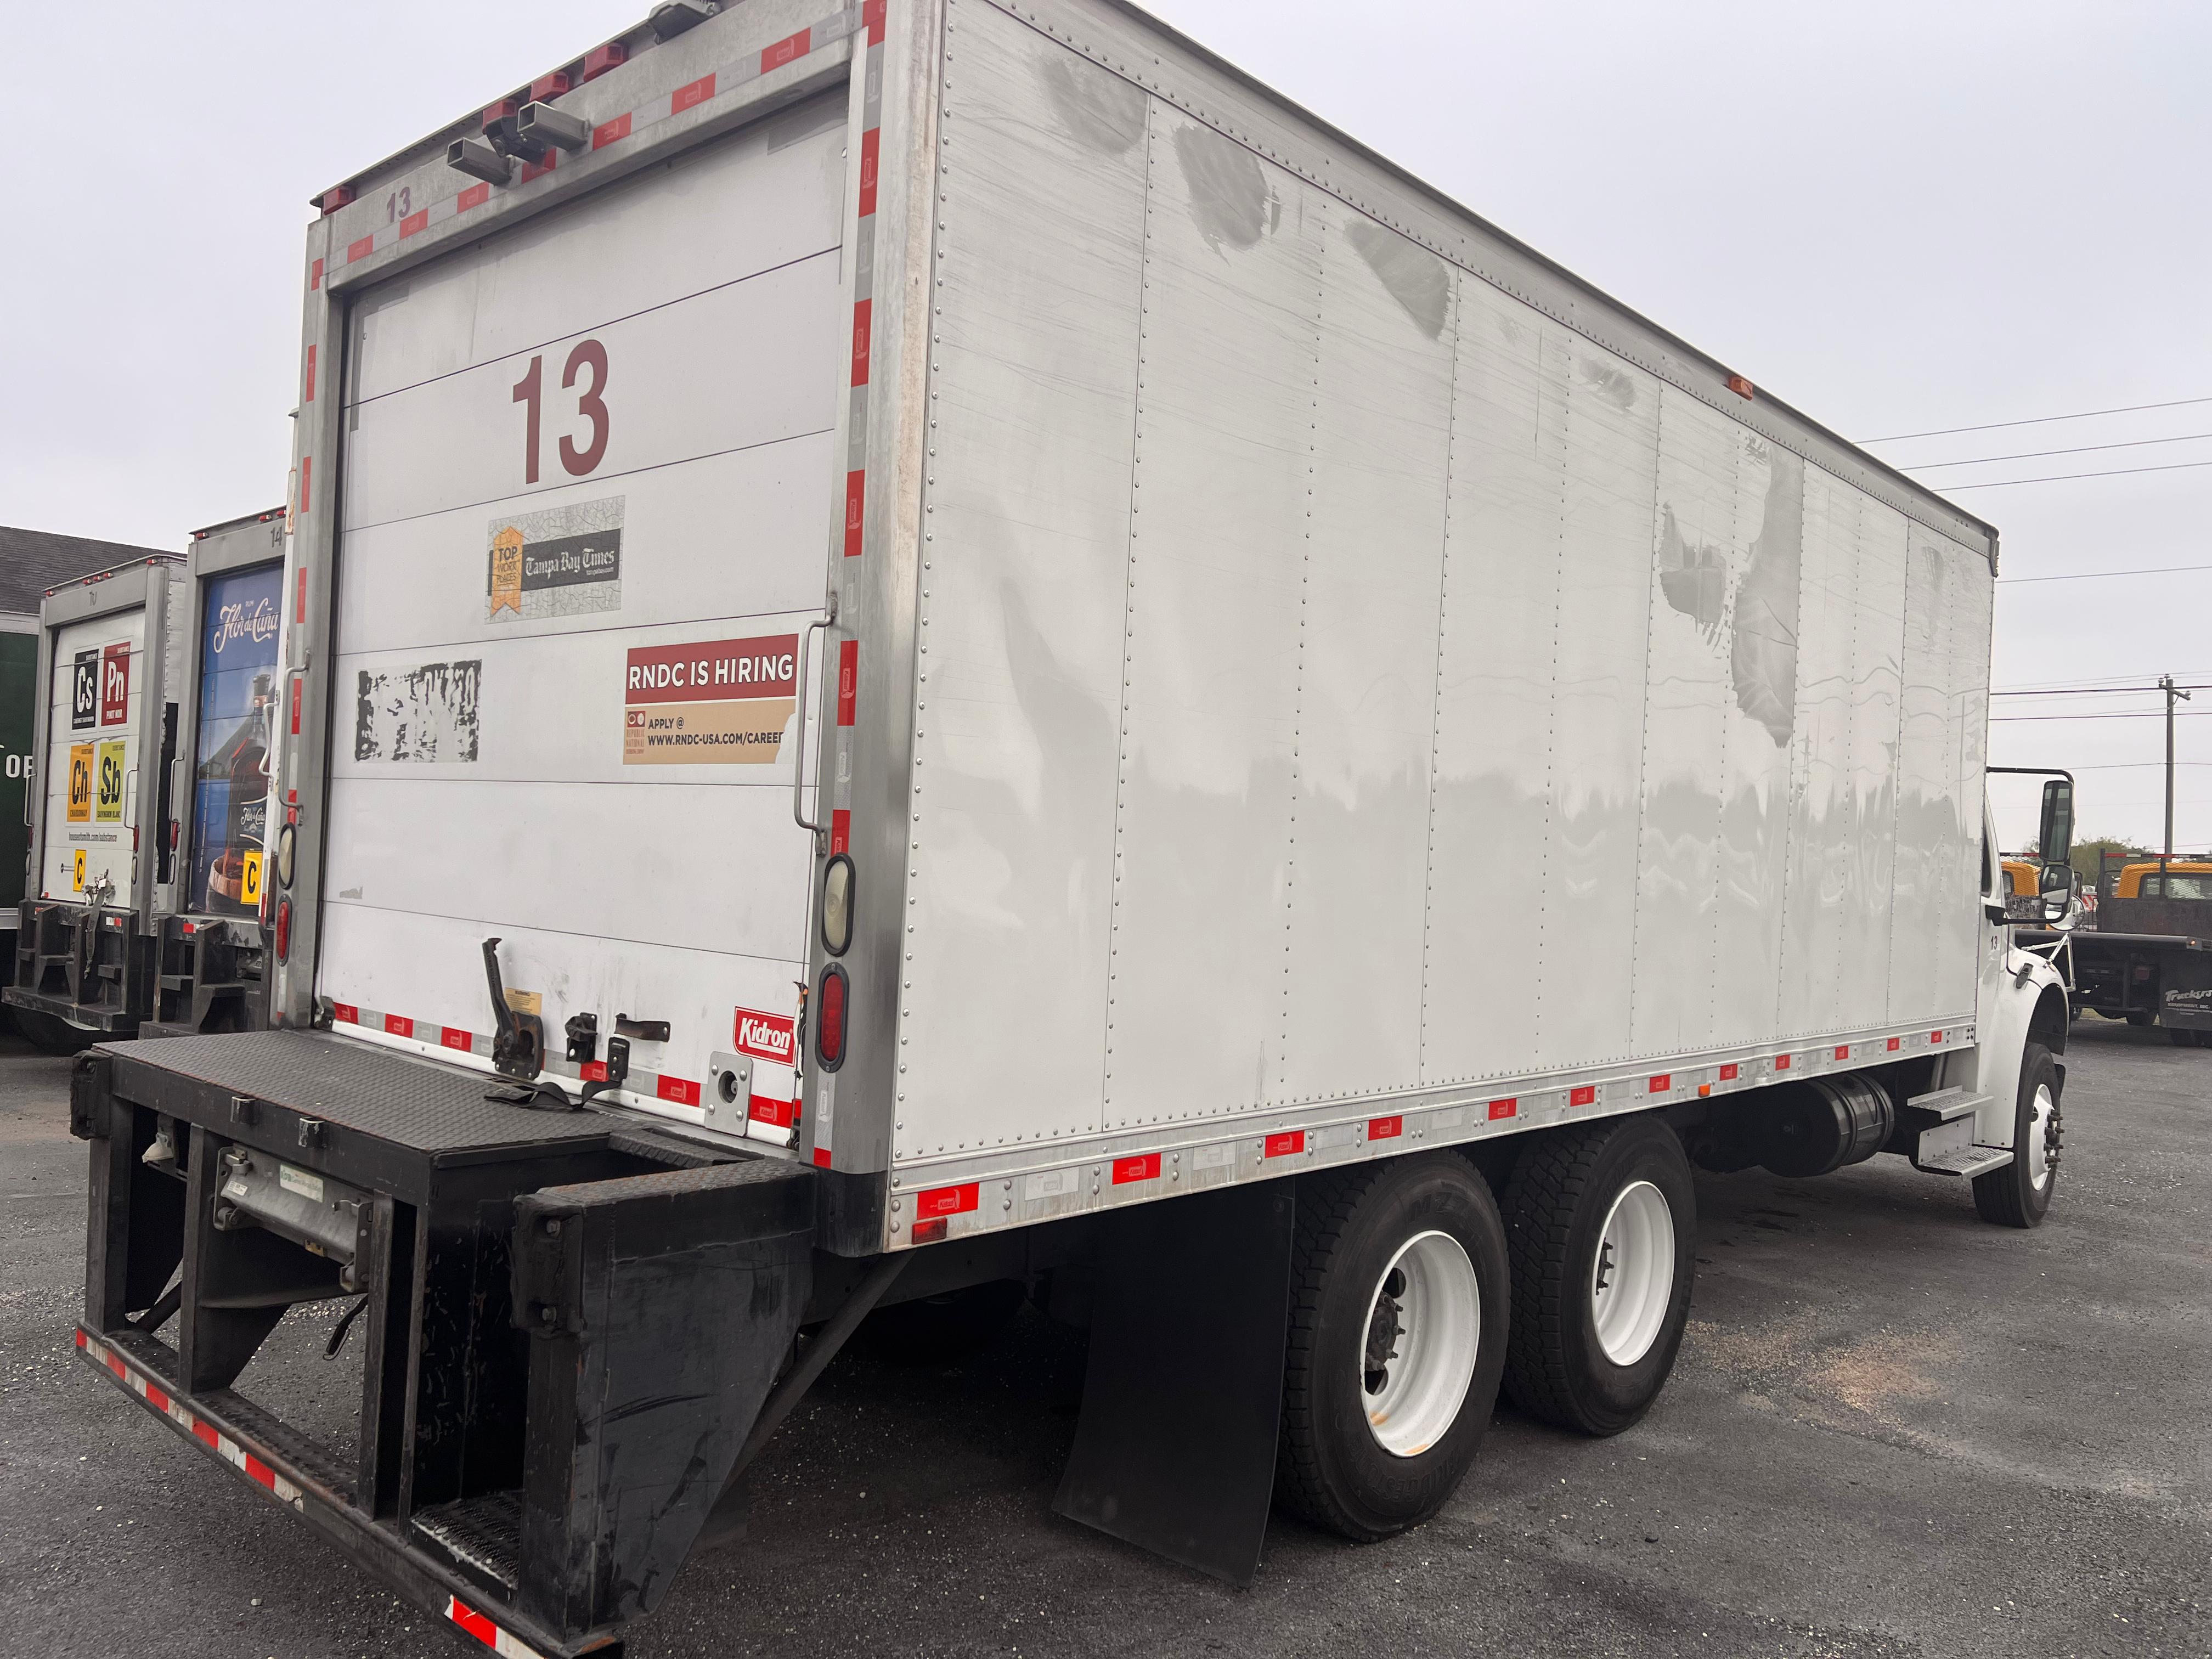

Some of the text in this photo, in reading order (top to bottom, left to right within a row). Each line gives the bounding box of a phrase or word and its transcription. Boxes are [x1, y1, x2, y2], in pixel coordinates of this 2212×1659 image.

[387, 187, 410, 223] 13
[513, 339, 609, 484] 13
[270, 525, 283, 548] 14
[498, 546, 518, 562] TOP
[526, 548, 615, 579] Tampa Bay Times
[213, 603, 244, 653] Flor
[77, 666, 93, 713] Cs
[107, 662, 124, 702] Pn
[629, 654, 793, 690] RNDC IS HIRING
[648, 716, 684, 730] APPLY @
[72, 760, 88, 804] Ch
[101, 756, 121, 805] Sb
[77, 857, 83, 884] C
[247, 861, 257, 894] C
[1991, 935, 1997, 950] 13
[738, 1018, 791, 1052] Kidron
